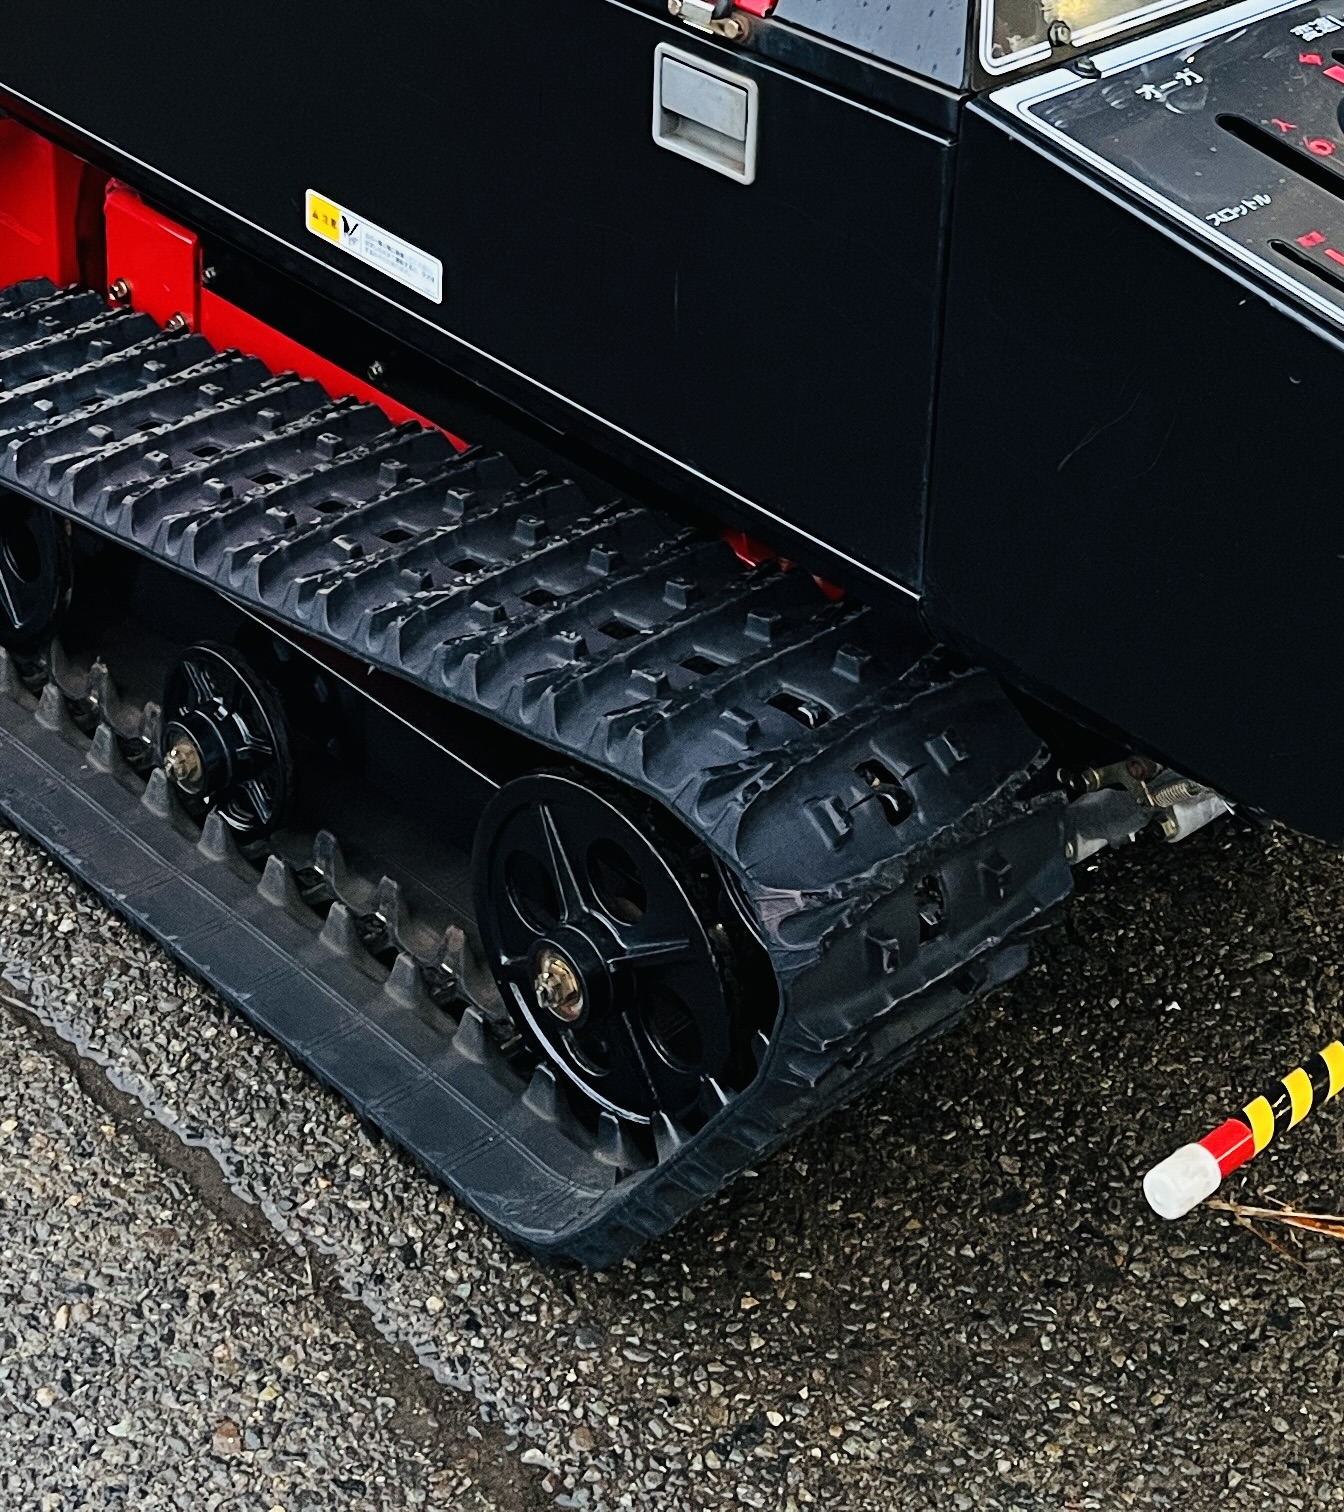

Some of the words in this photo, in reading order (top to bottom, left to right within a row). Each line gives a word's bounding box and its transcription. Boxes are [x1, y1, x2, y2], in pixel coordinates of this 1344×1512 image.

[1205, 193, 1272, 228] スロットル
